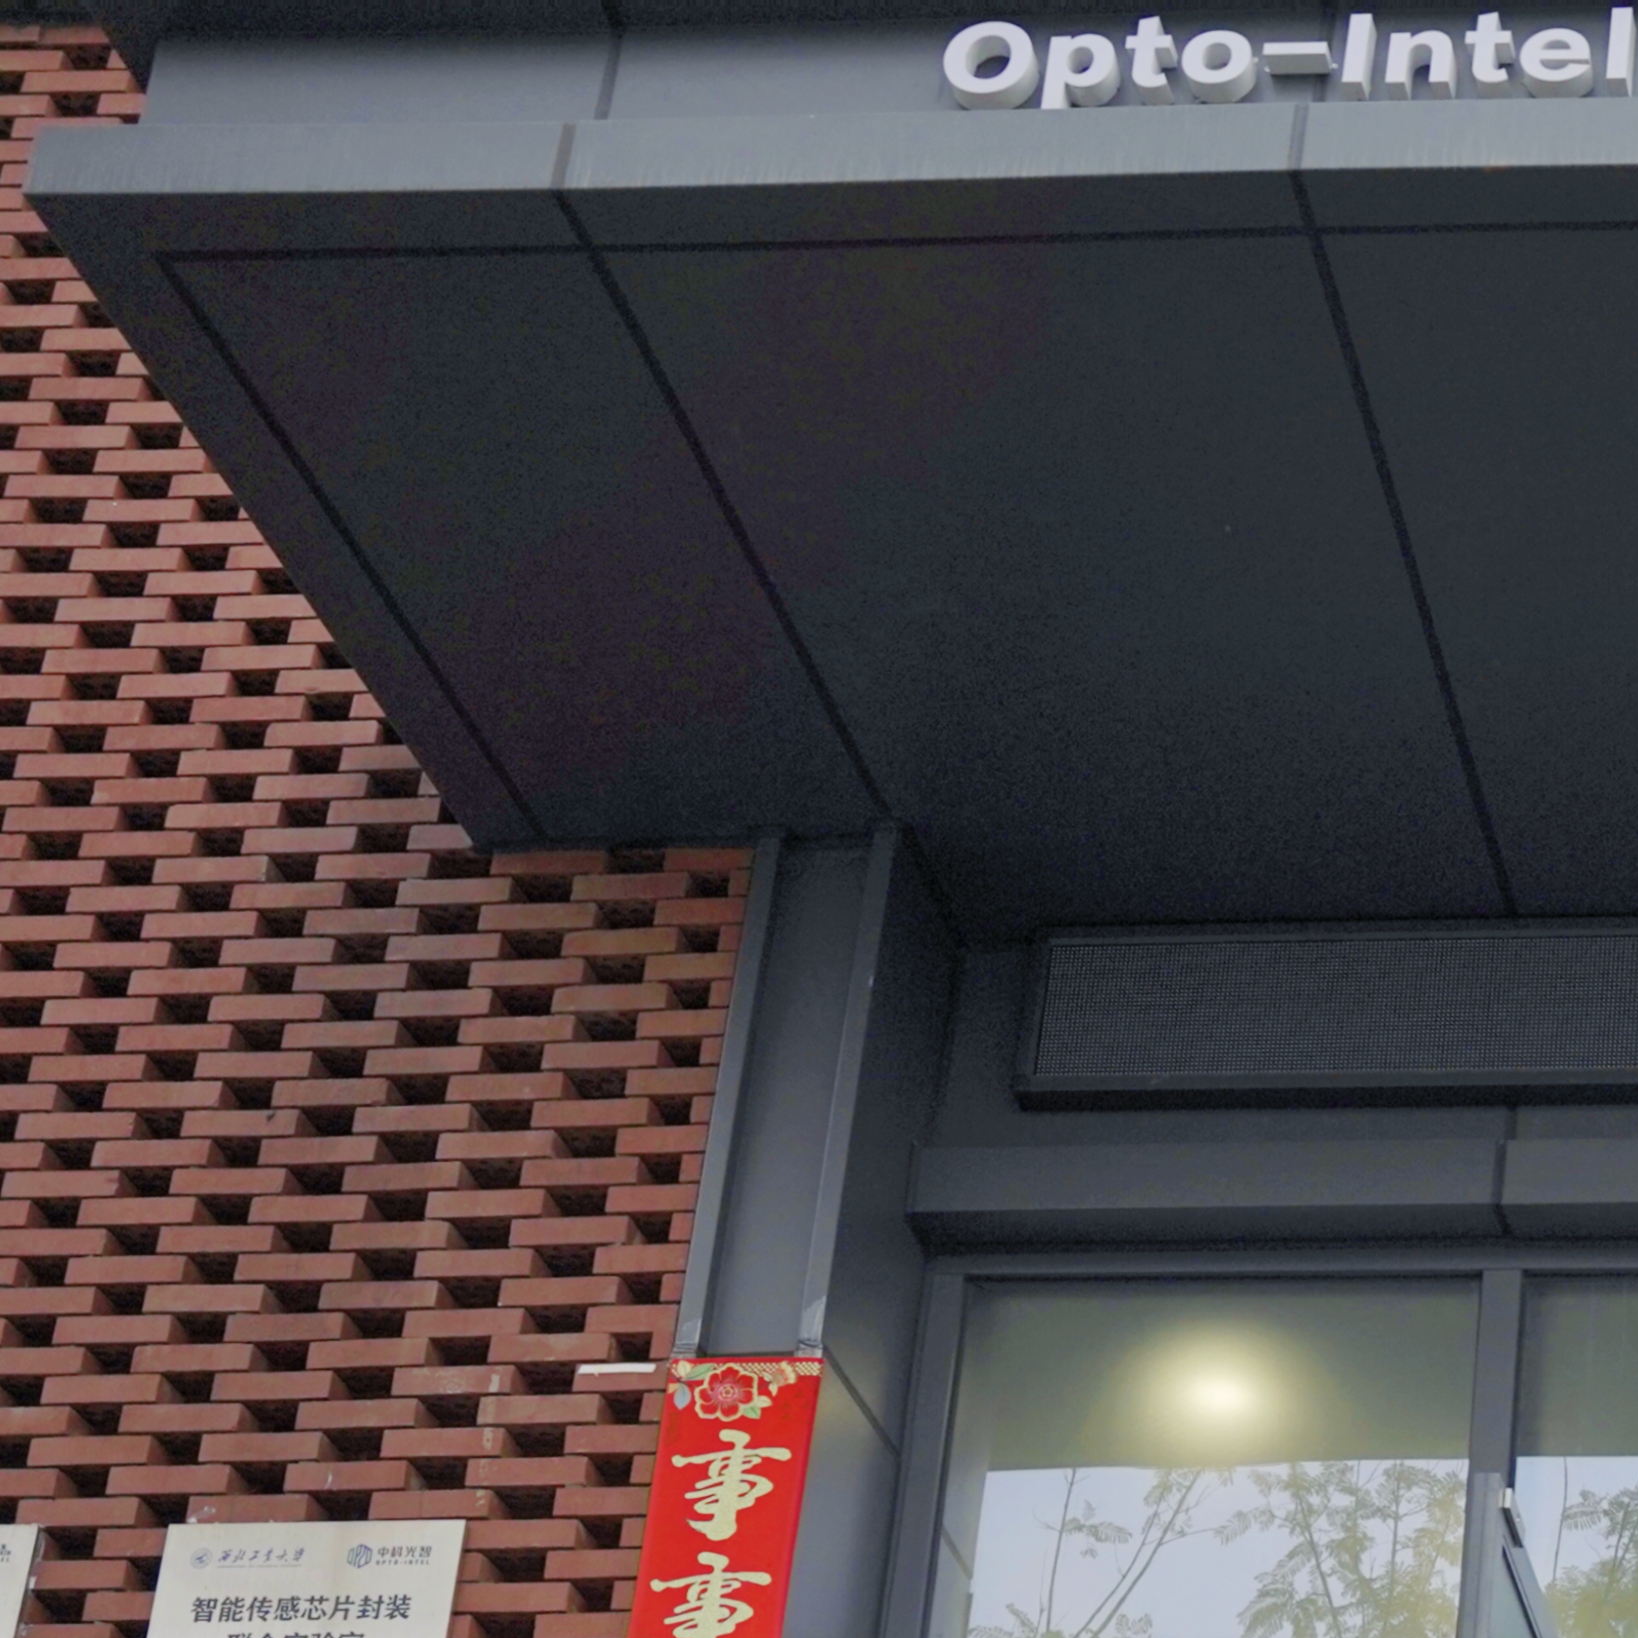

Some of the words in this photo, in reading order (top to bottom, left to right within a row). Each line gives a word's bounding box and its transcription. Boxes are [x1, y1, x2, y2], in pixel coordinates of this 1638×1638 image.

[942, 6, 1637, 110] Opto-Intel
[191, 1594, 412, 1623] 智能传感芯片封装
